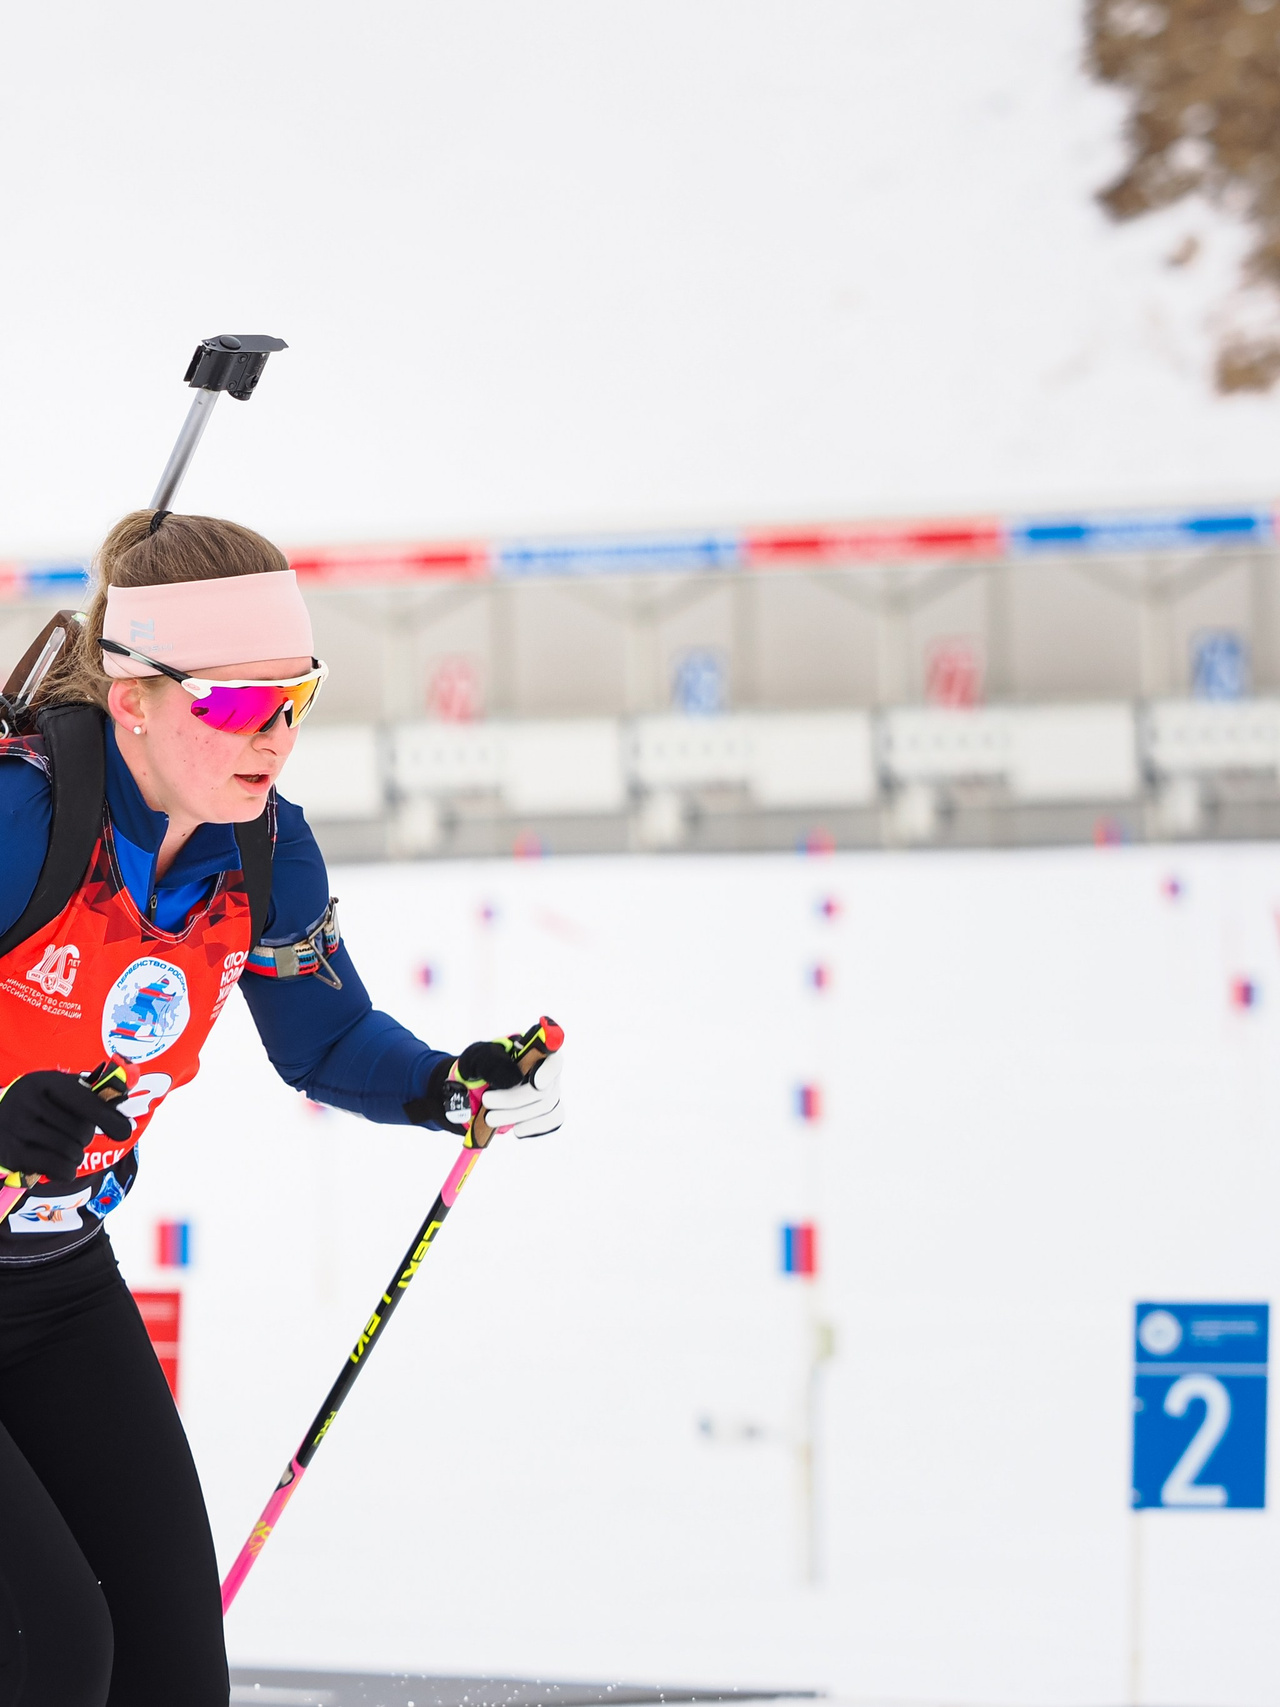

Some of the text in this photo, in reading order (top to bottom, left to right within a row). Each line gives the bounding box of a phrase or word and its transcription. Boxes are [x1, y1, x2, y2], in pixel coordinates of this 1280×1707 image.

[116, 959, 167, 989] ПЕРВЕНСТВО
[5, 978, 58, 1006] МИНИСТЕРСТВО
[58, 1000, 82, 1011] СПОРТА
[41, 1004, 82, 1020] ФЕДЕРАЦИИ
[397, 1220, 443, 1289] LEKI
[1159, 1373, 1232, 1508] 2
